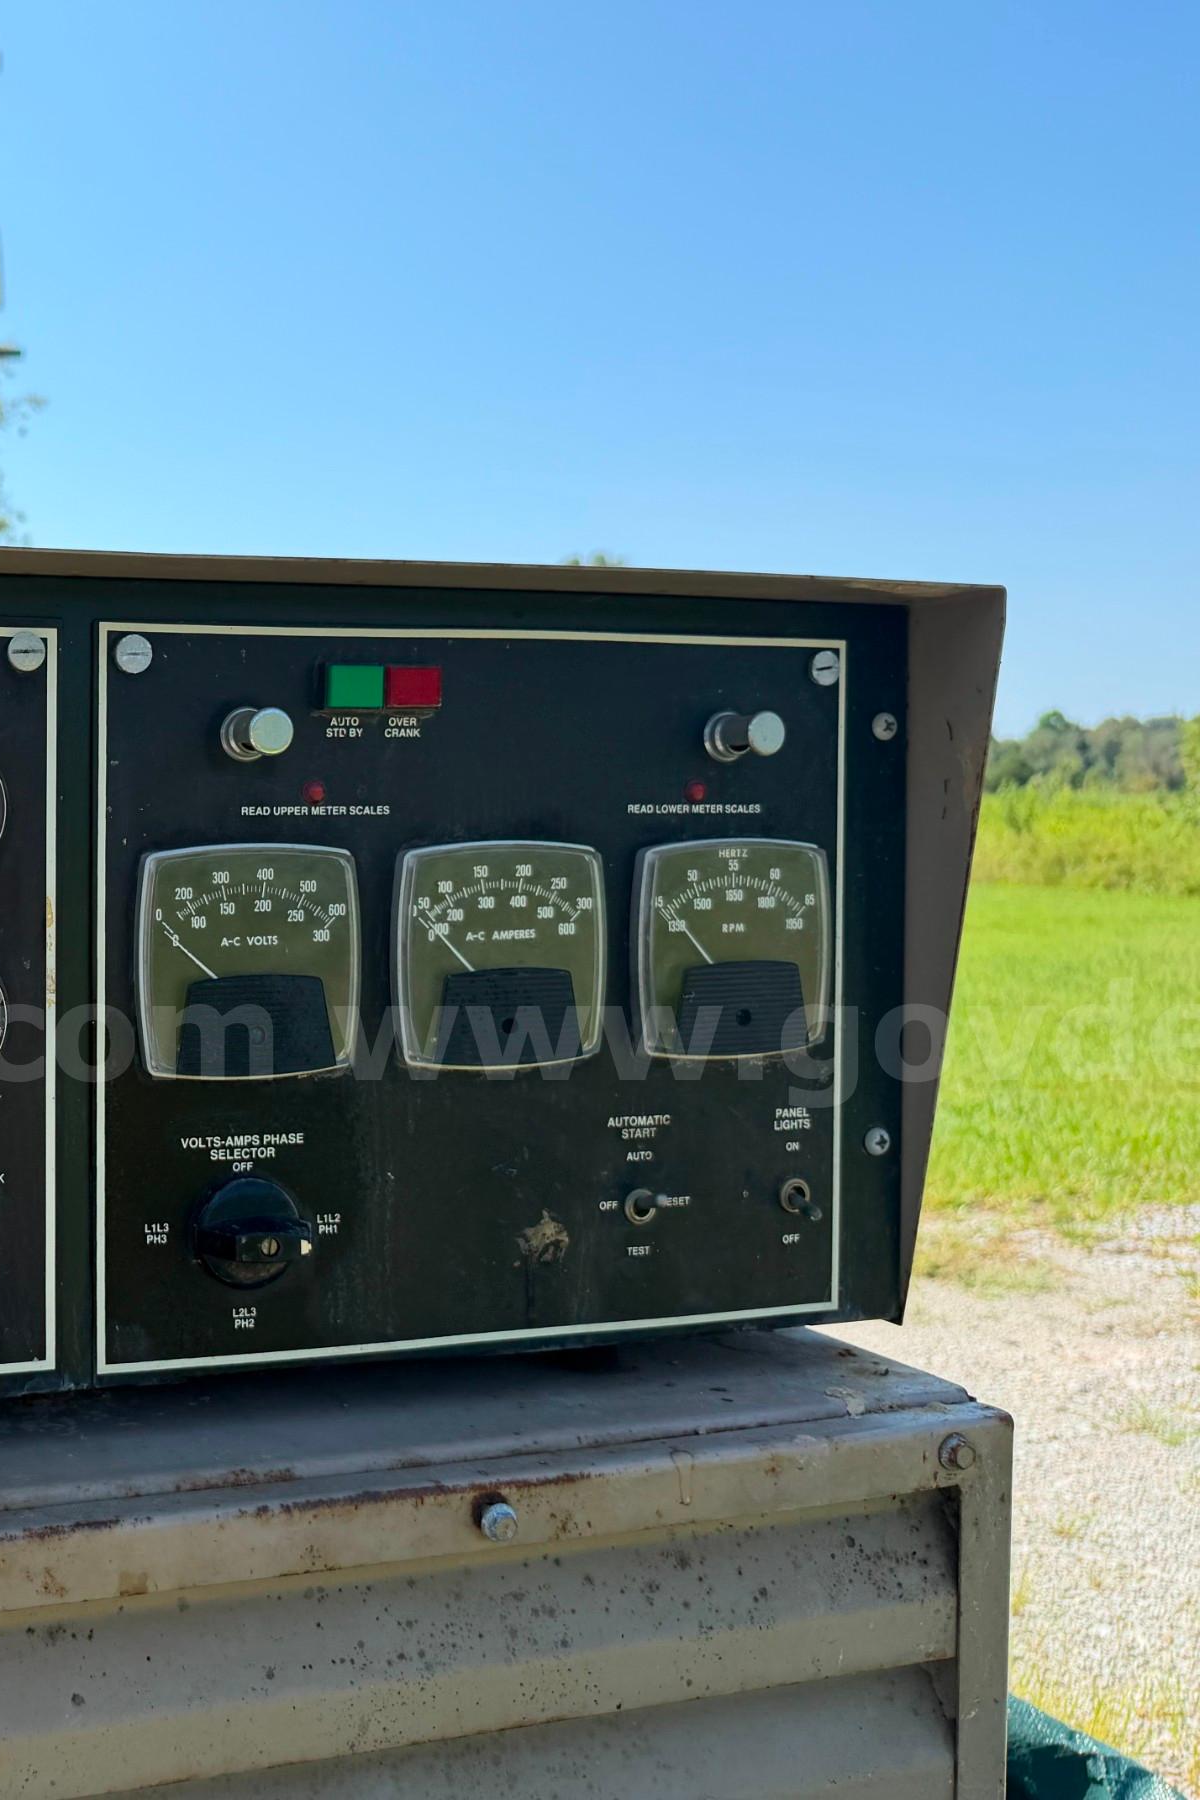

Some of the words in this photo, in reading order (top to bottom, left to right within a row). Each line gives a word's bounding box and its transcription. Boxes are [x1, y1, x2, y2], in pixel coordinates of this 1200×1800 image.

[330, 717, 360, 727] AUTO
[389, 717, 417, 727] OVER
[326, 728, 347, 738] STD
[349, 728, 363, 738] BY
[385, 728, 421, 738] CRANK
[241, 806, 271, 816] READ
[273, 806, 308, 816] UPPER
[311, 805, 347, 815] METER
[349, 805, 390, 815] SCALES
[628, 805, 654, 814] READ
[656, 805, 689, 814] LOWER
[692, 805, 723, 814] METER
[725, 804, 761, 813] SCALES
[719, 850, 748, 858] HERTZ
[418, 897, 430, 909] 50
[438, 881, 452, 893] 100
[473, 865, 488, 877] 150
[515, 864, 531, 877] 200
[550, 878, 567, 889] 250
[576, 897, 592, 909] 300
[687, 870, 698, 881] 50
[729, 860, 738, 871] 55
[770, 869, 780, 880] 60
[805, 895, 815, 906] 65
[156, 909, 162, 921] 0
[175, 888, 193, 900] 200
[212, 872, 230, 884] 300
[256, 868, 274, 880] 400
[300, 880, 316, 892] 500
[328, 904, 346, 916] 600
[693, 899, 711, 910] 1500
[726, 890, 742, 901] 1650
[758, 897, 775, 908] 1800
[786, 918, 803, 929] 1950
[191, 916, 206, 928] 100
[220, 903, 235, 915] 150
[254, 900, 271, 912] 200
[287, 910, 304, 922] 250
[313, 929, 330, 942] 300
[428, 929, 435, 941] 0
[447, 909, 463, 921] 200
[478, 897, 494, 909] 300
[510, 896, 526, 908] 400
[537, 907, 553, 919] 500
[558, 923, 575, 935] 600
[722, 924, 744, 932] RPM
[466, 931, 485, 941] A-C
[492, 929, 536, 940] AMPERES
[221, 936, 240, 946] A-C
[247, 935, 278, 946] VOLTS
[775, 1108, 810, 1118] PANEL
[608, 1115, 670, 1127] AUTOMATIC
[774, 1120, 811, 1130] LIGHTS
[621, 1128, 656, 1139] START
[181, 1135, 260, 1148] VOLTS-AMPS
[264, 1133, 304, 1144] PHASE
[786, 1142, 799, 1151] ON
[210, 1147, 276, 1160] SELECTOR
[627, 1151, 652, 1161] AUTO
[232, 1162, 253, 1172] OFF
[600, 1200, 618, 1210] OFF
[666, 1196, 690, 1206] ESET
[317, 1214, 340, 1223] L1L2
[145, 1223, 169, 1233] L1L3
[319, 1225, 338, 1234] PH1
[147, 1235, 167, 1244] PH3
[782, 1234, 800, 1244] OFF
[627, 1246, 650, 1256] TEST
[233, 1308, 256, 1317] L2L3
[234, 1319, 255, 1328] PH2
